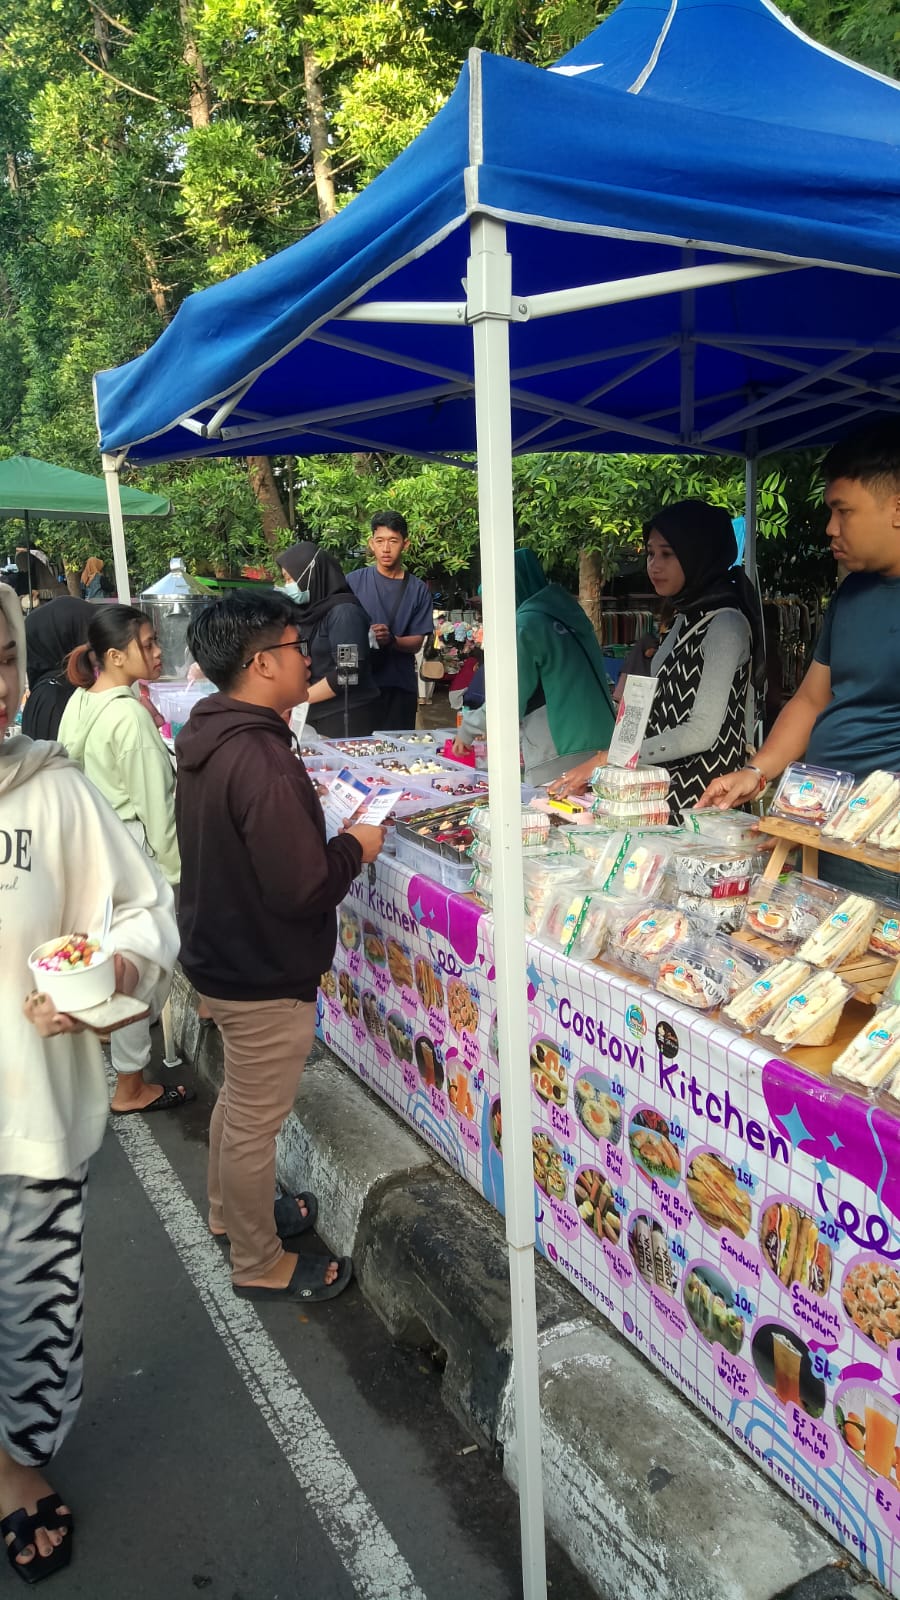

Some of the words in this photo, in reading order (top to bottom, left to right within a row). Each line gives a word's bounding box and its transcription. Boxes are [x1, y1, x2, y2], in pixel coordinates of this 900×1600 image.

[368, 884, 419, 936] Kitchen
[558, 997, 645, 1073] Costovi
[658, 1051, 789, 1164] Kitchen
[669, 1122, 686, 1142] 10k
[737, 1168, 754, 1188] 15k
[673, 1196, 693, 1223] Beef
[819, 1220, 840, 1244] 20k
[671, 1240, 686, 1260] 10k
[720, 1237, 760, 1279] Sandwich
[734, 1293, 753, 1316] 10k
[791, 1285, 841, 1332] Sandwich
[792, 1302, 838, 1343] Gandum
[814, 1355, 832, 1381] 5k
[793, 1407, 806, 1428] Es
[810, 1423, 829, 1450] Teh
[875, 1488, 893, 1512] Es
